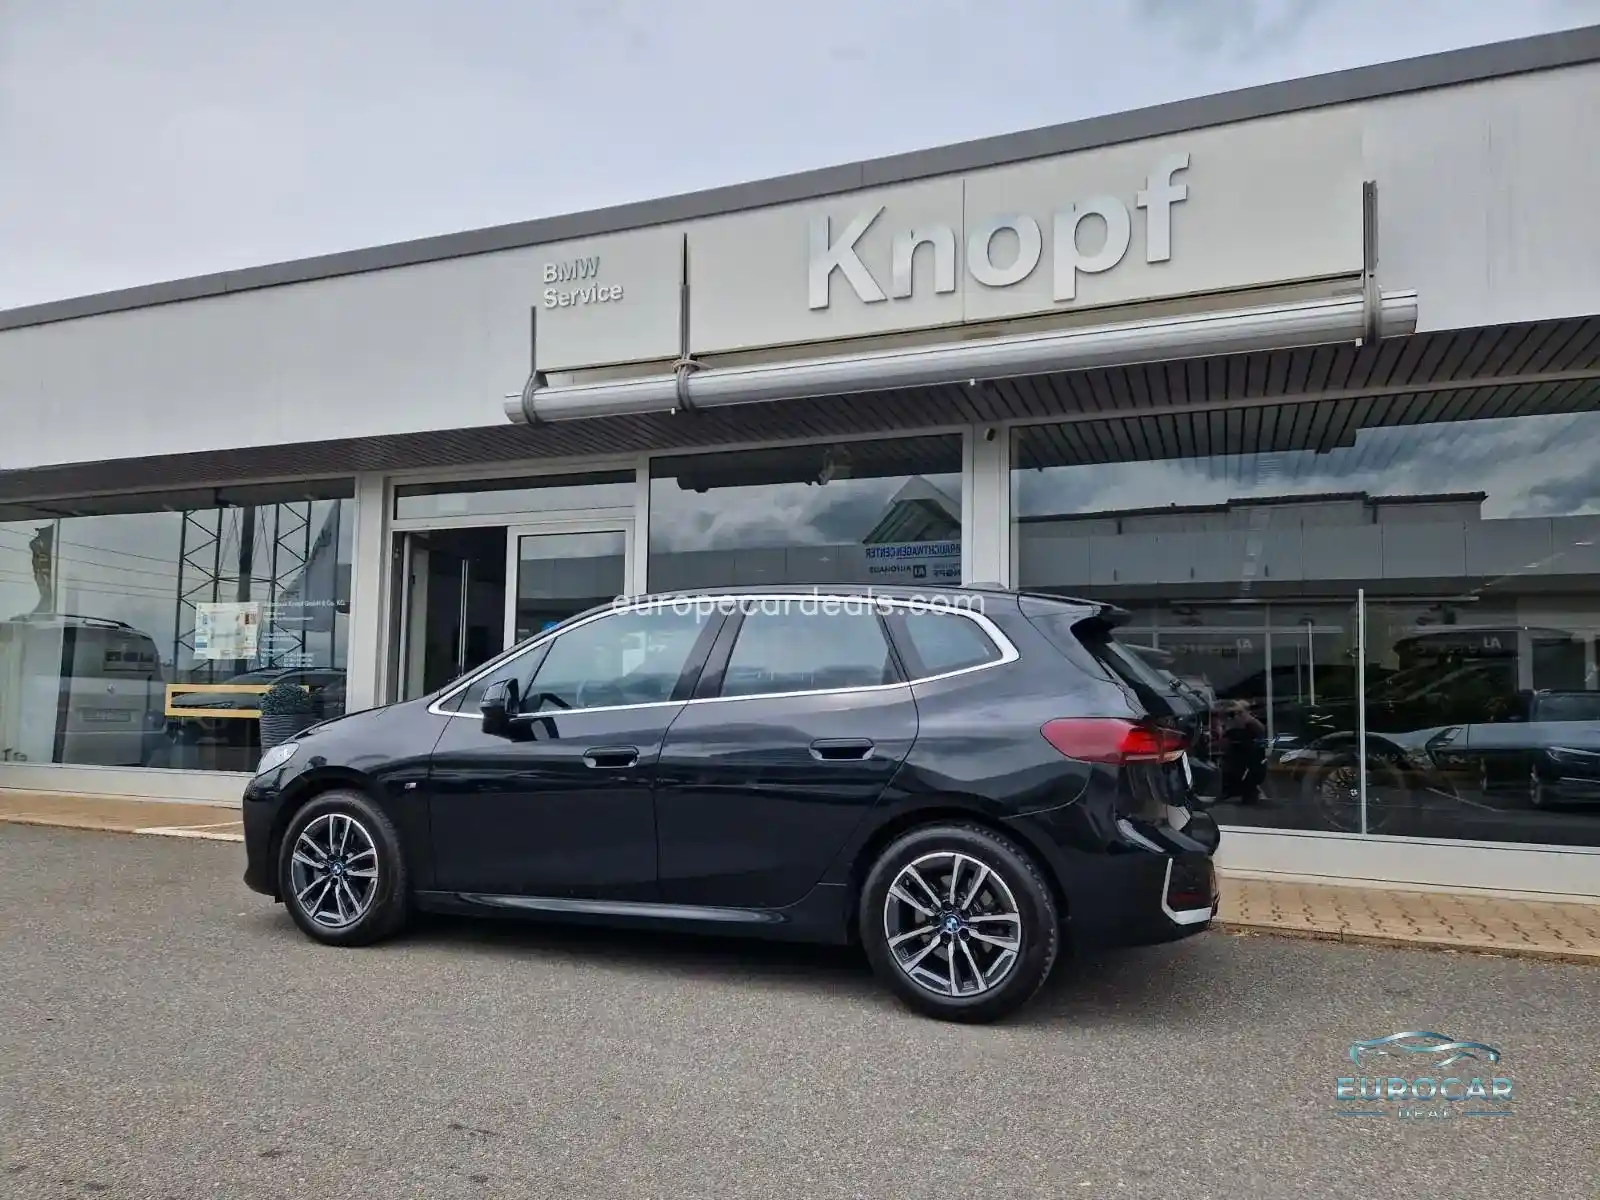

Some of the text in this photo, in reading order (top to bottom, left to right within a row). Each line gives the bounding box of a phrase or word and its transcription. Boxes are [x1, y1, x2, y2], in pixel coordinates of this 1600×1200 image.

[808, 152, 1191, 311] Knopf
[543, 255, 601, 285] BMW
[543, 282, 624, 309] Service
